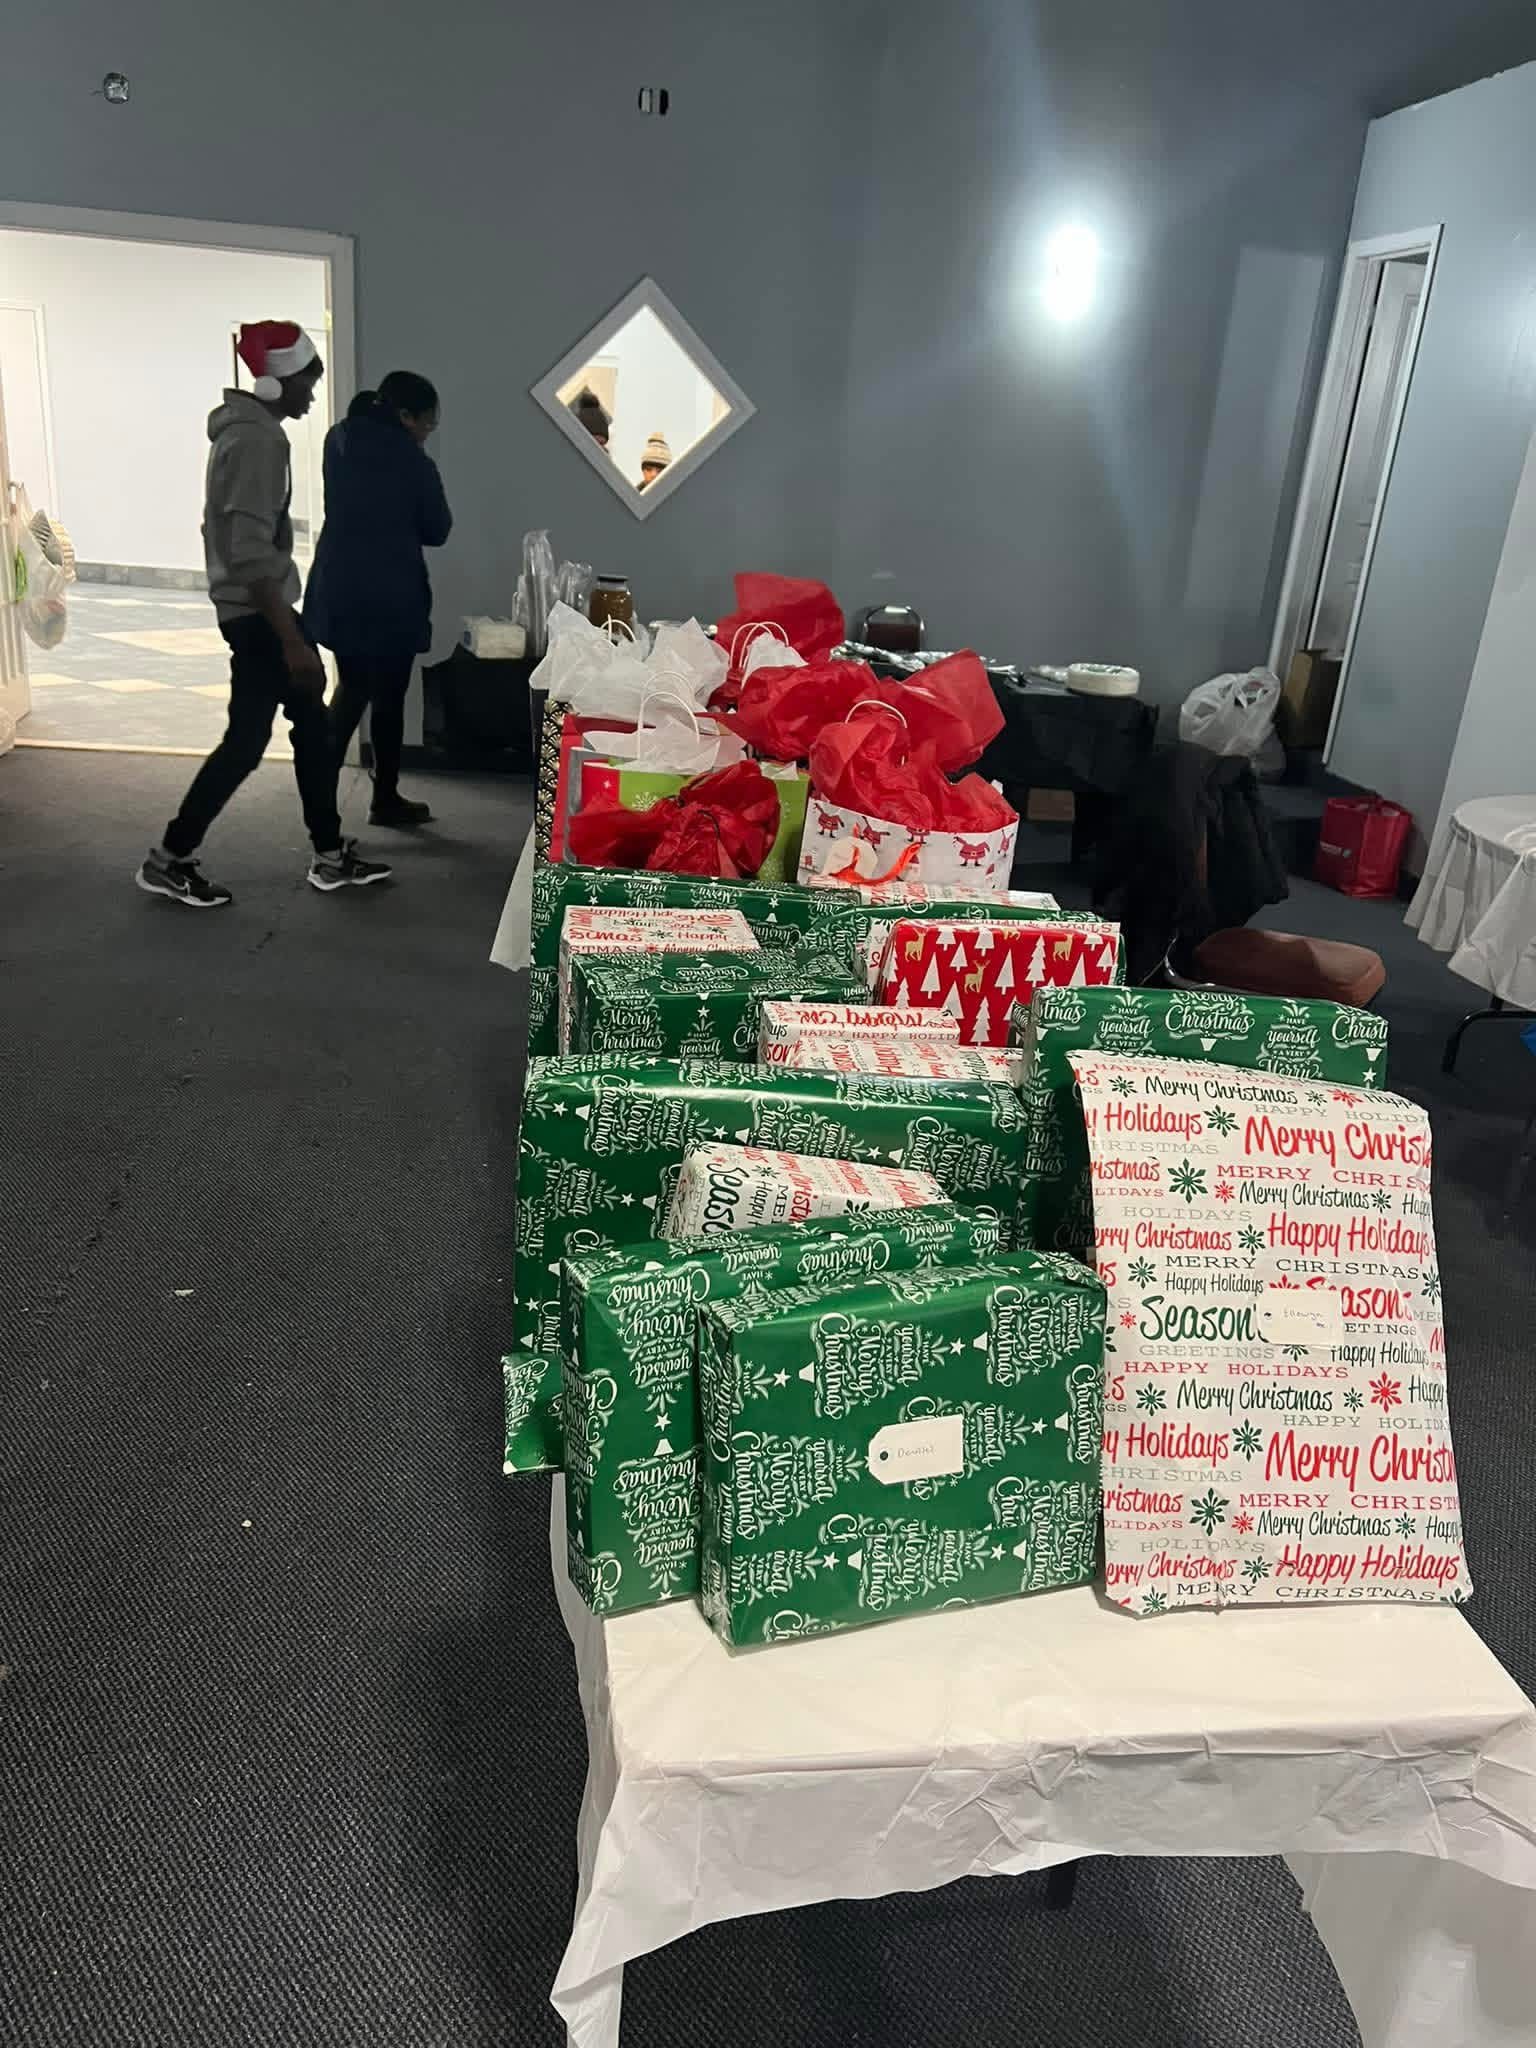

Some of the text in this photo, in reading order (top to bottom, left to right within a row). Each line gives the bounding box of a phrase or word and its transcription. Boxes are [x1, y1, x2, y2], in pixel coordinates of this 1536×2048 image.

[603, 1009, 657, 1032] Merry
[1099, 1018, 1153, 1036] yourself
[1165, 1003, 1255, 1034] Christmas
[1267, 1027, 1321, 1047] yourself
[1331, 1014, 1388, 1041] Christ
[591, 1031, 667, 1053] Christmas
[1145, 1075, 1299, 1105] Merry Christmas
[592, 1074, 628, 1157] Christmas
[1103, 1101, 1202, 1141] Holidays
[1244, 1115, 1336, 1169] Merry
[1216, 1164, 1312, 1181] MERRY
[1122, 1206, 1253, 1221] HOLIDAYS
[1239, 1180, 1288, 1210] Merry
[1291, 1183, 1370, 1210] Christmas
[1134, 1221, 1233, 1251] Christmas
[1267, 1212, 1430, 1265] Happy Holidays
[797, 1239, 891, 1275] Christmas
[1166, 1255, 1420, 1280] MERRY CHRISTMAS
[607, 1268, 710, 1307] Christmas
[1165, 1272, 1264, 1297] Happy Holidays
[624, 1307, 696, 1344] Merry
[993, 1284, 1023, 1388] Christmas
[1019, 1296, 1050, 1368] Merry
[1061, 1293, 1081, 1356] yourself
[1139, 1295, 1270, 1344] Season'
[629, 1348, 693, 1385] yourself
[819, 1312, 851, 1420] Christmas
[848, 1324, 881, 1399] Merry
[894, 1323, 919, 1388] yourself
[1124, 1361, 1349, 1379] HAPPY HOLIDAYS
[1139, 1345, 1275, 1359] GREETINGS
[1071, 1364, 1096, 1464] Christmas
[1176, 1378, 1235, 1416] Merry
[1239, 1380, 1333, 1411] Christmas
[977, 1403, 1002, 1468] yourself
[1283, 1414, 1361, 1428] HAPPY
[1126, 1422, 1230, 1468] Holidays
[1265, 1429, 1360, 1492] Merry
[613, 1458, 703, 1492] hristmas
[732, 1431, 763, 1540] Christmas
[762, 1441, 794, 1517] Merry
[805, 1437, 833, 1505] yourself
[628, 1488, 701, 1527] Merry
[1239, 1493, 1330, 1508] MERRY
[1258, 1509, 1304, 1541] Merry
[1308, 1511, 1391, 1537] Christmas
[633, 1528, 697, 1565] yourself
[1140, 1537, 1265, 1553] HOLIDAYS
[1276, 1543, 1460, 1589] Happy Holidays
